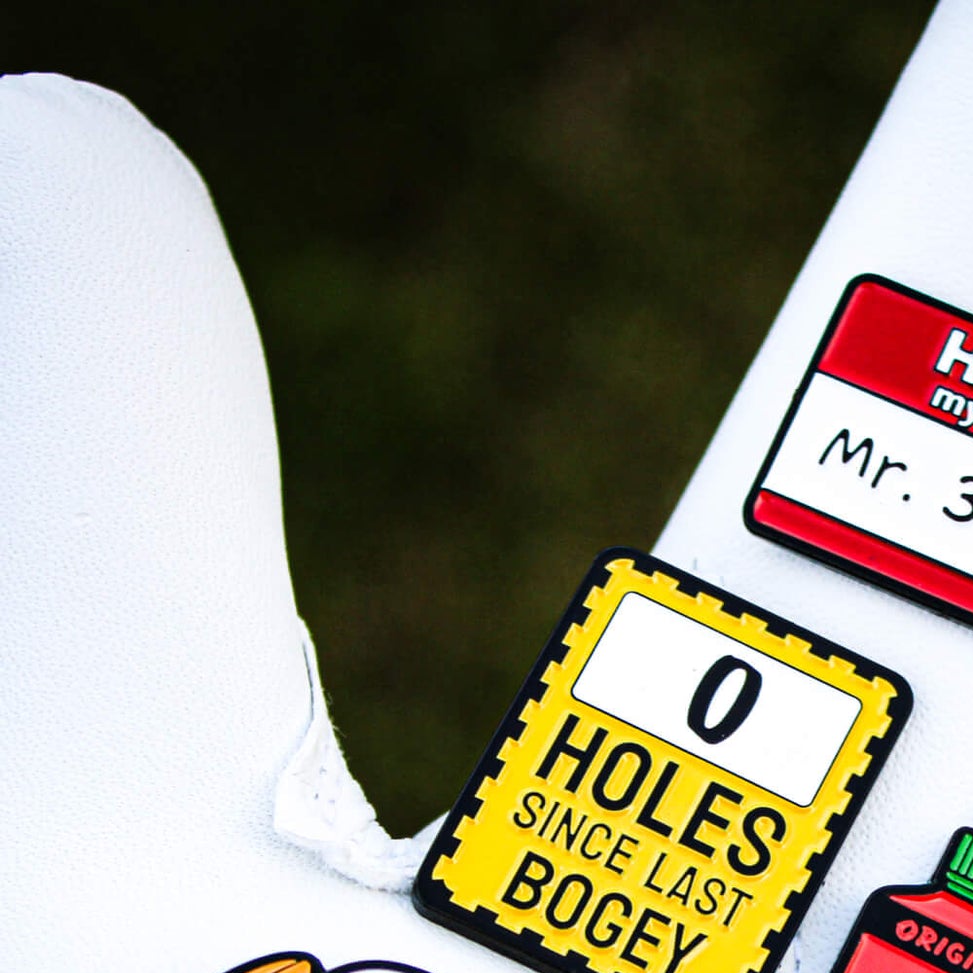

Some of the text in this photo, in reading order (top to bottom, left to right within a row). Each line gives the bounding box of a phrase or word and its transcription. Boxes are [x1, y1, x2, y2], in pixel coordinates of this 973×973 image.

[818, 428, 911, 502] Mr.
[687, 655, 763, 745] 0
[535, 714, 787, 877] HOLES
[513, 791, 753, 928] SINCE LAST
